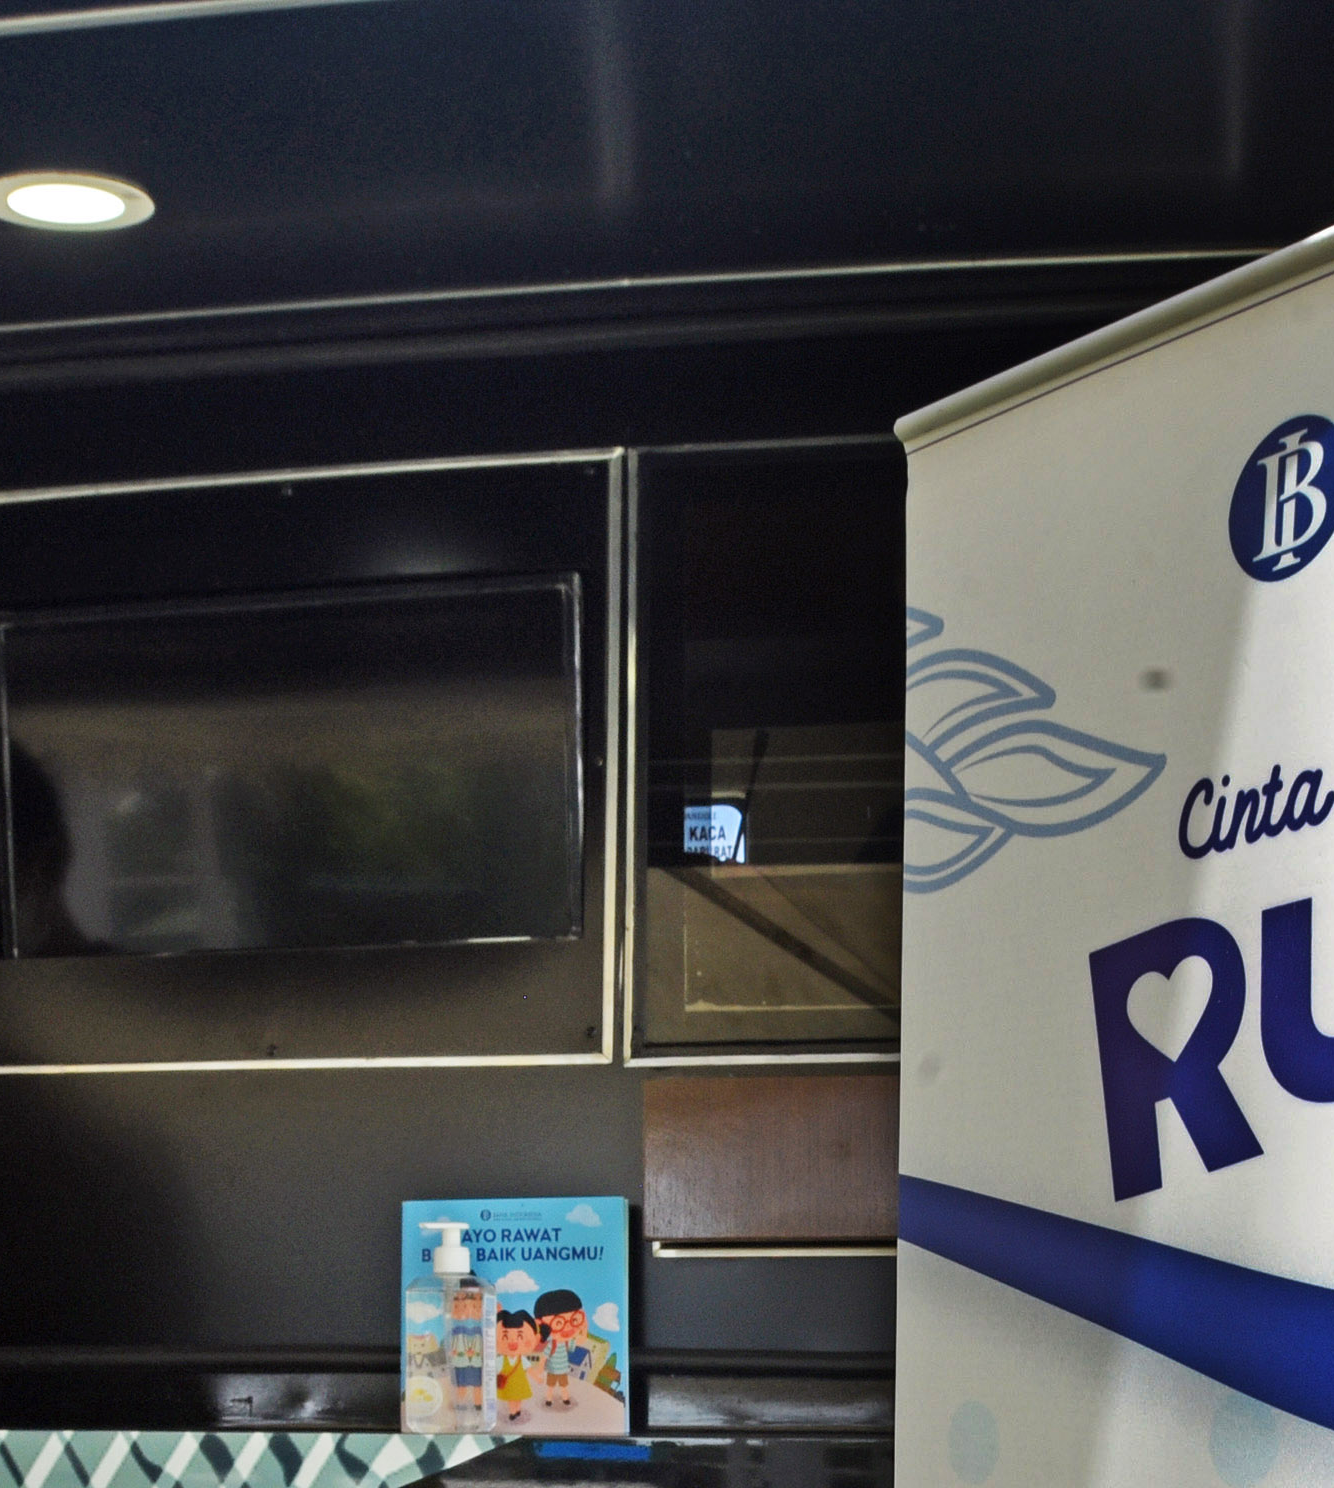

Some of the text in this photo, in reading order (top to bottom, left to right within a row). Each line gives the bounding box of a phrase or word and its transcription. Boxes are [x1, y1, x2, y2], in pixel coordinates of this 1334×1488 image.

[689, 826, 726, 841] KACA
[461, 1228, 562, 1243] AYO RAWAT
[477, 1247, 603, 1261] BAIK UANGMU!
